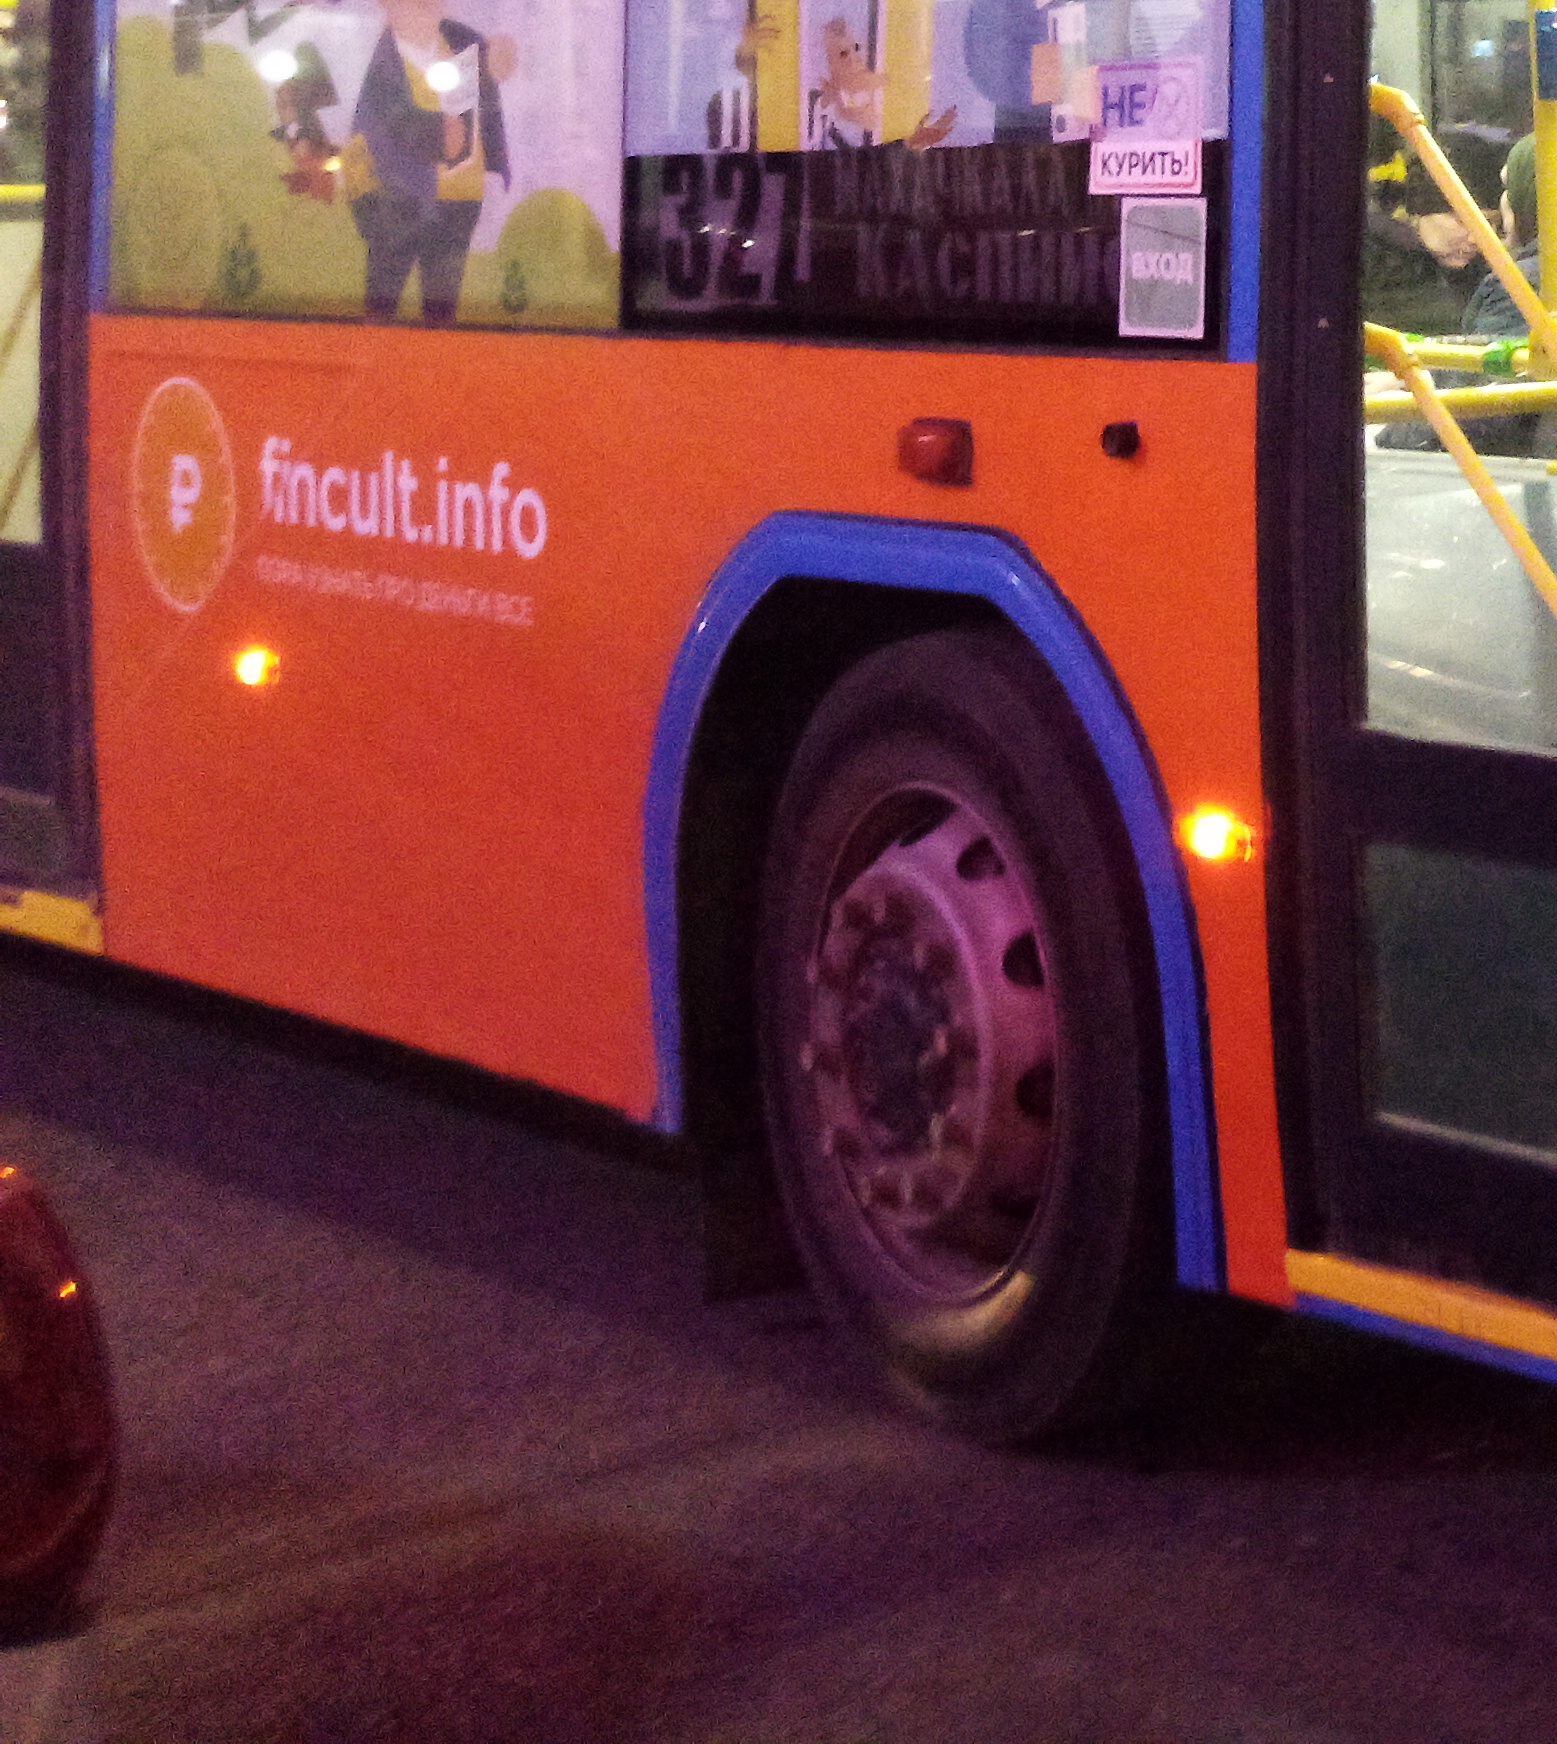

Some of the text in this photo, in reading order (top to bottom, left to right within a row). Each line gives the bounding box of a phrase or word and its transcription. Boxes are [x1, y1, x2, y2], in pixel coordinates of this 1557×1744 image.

[1101, 81, 1149, 128] НЕ
[1100, 150, 1190, 177] КУРИТЬ!
[1131, 252, 1194, 285] ВХОД
[259, 435, 549, 559] fincult.info
